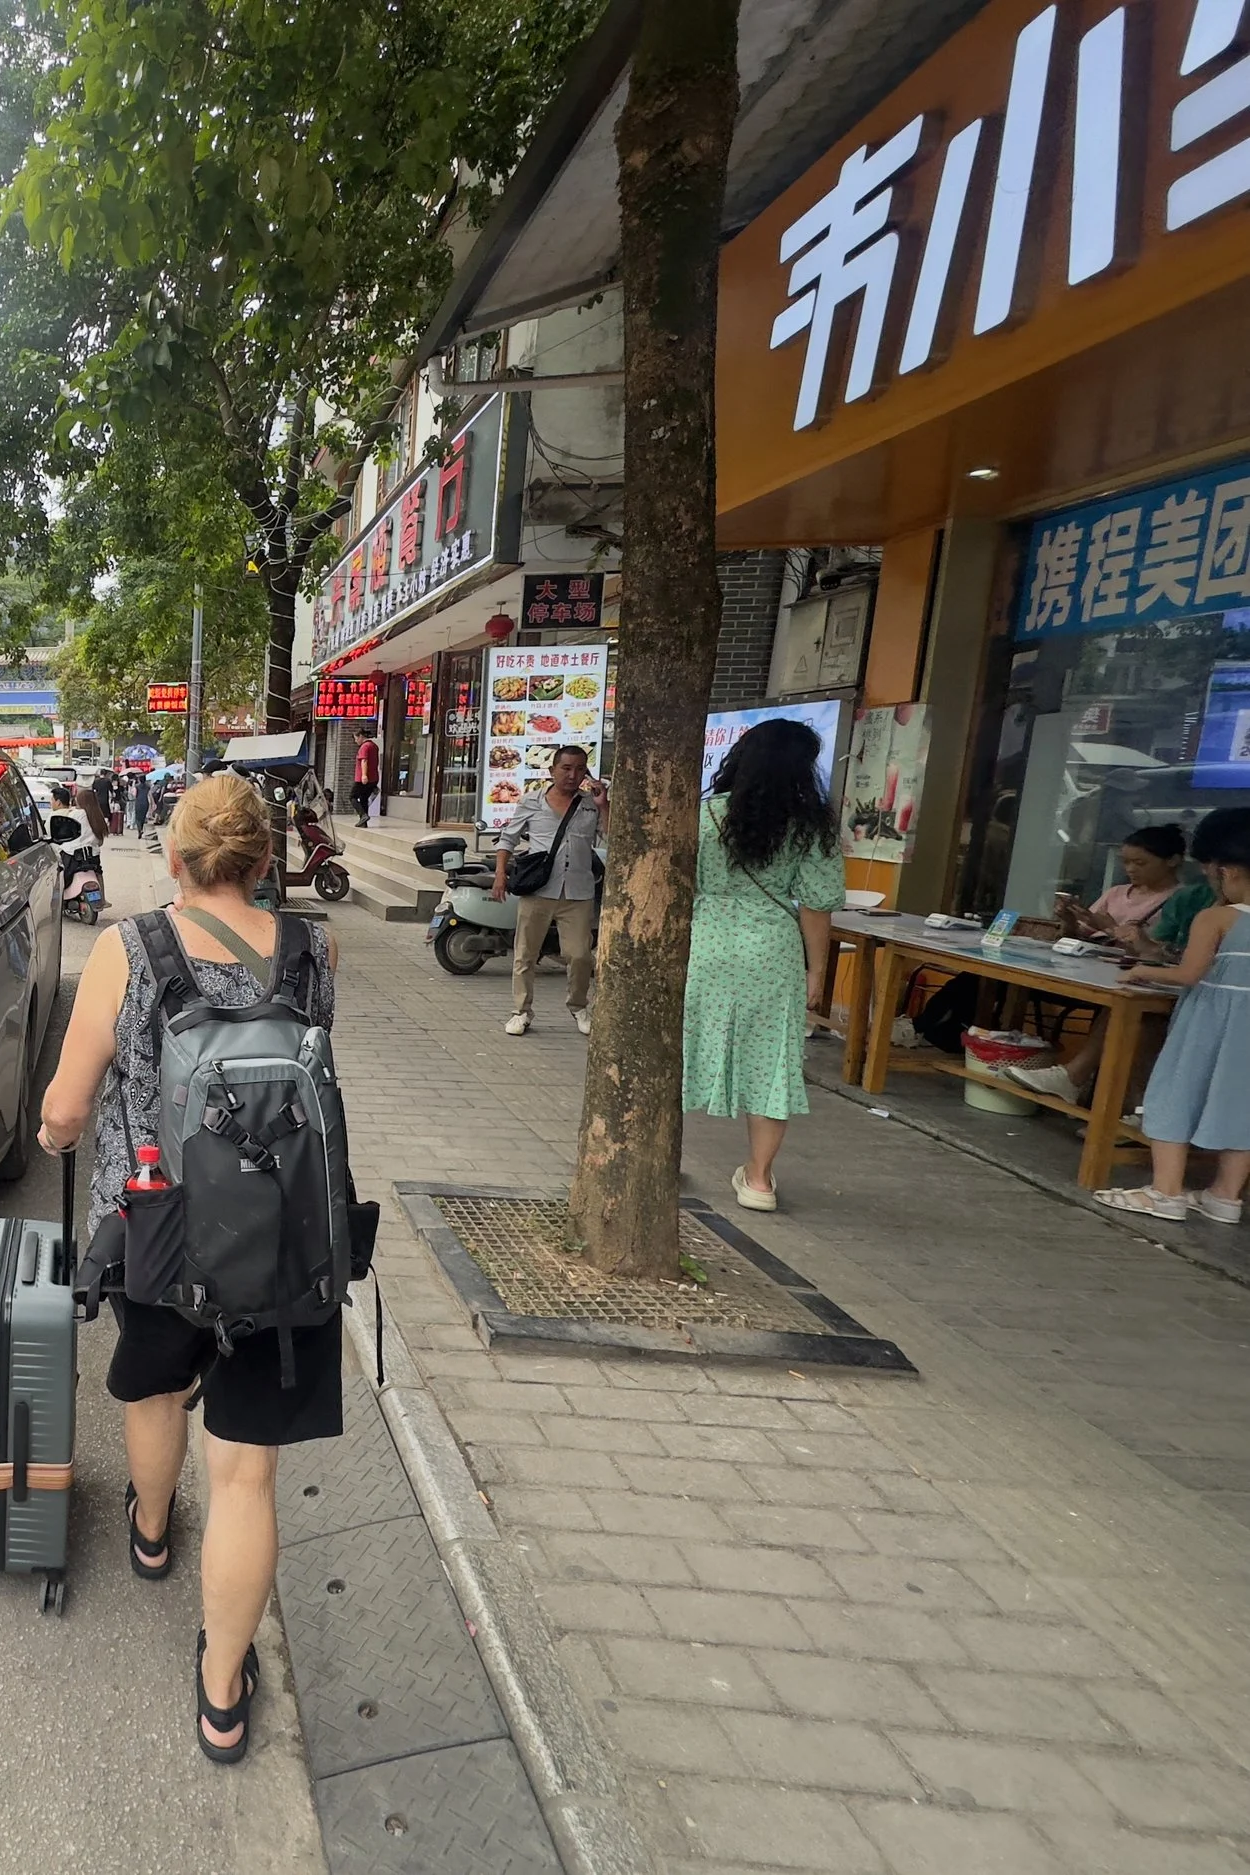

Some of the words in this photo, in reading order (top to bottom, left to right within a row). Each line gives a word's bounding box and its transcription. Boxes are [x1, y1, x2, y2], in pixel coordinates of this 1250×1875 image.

[1024, 476, 1250, 632] 携程美团
[535, 579, 591, 600] 大型
[527, 602, 596, 623] 停车场
[496, 655, 535, 668] 好吃不贵
[540, 652, 600, 668] 地道本土餐厅
